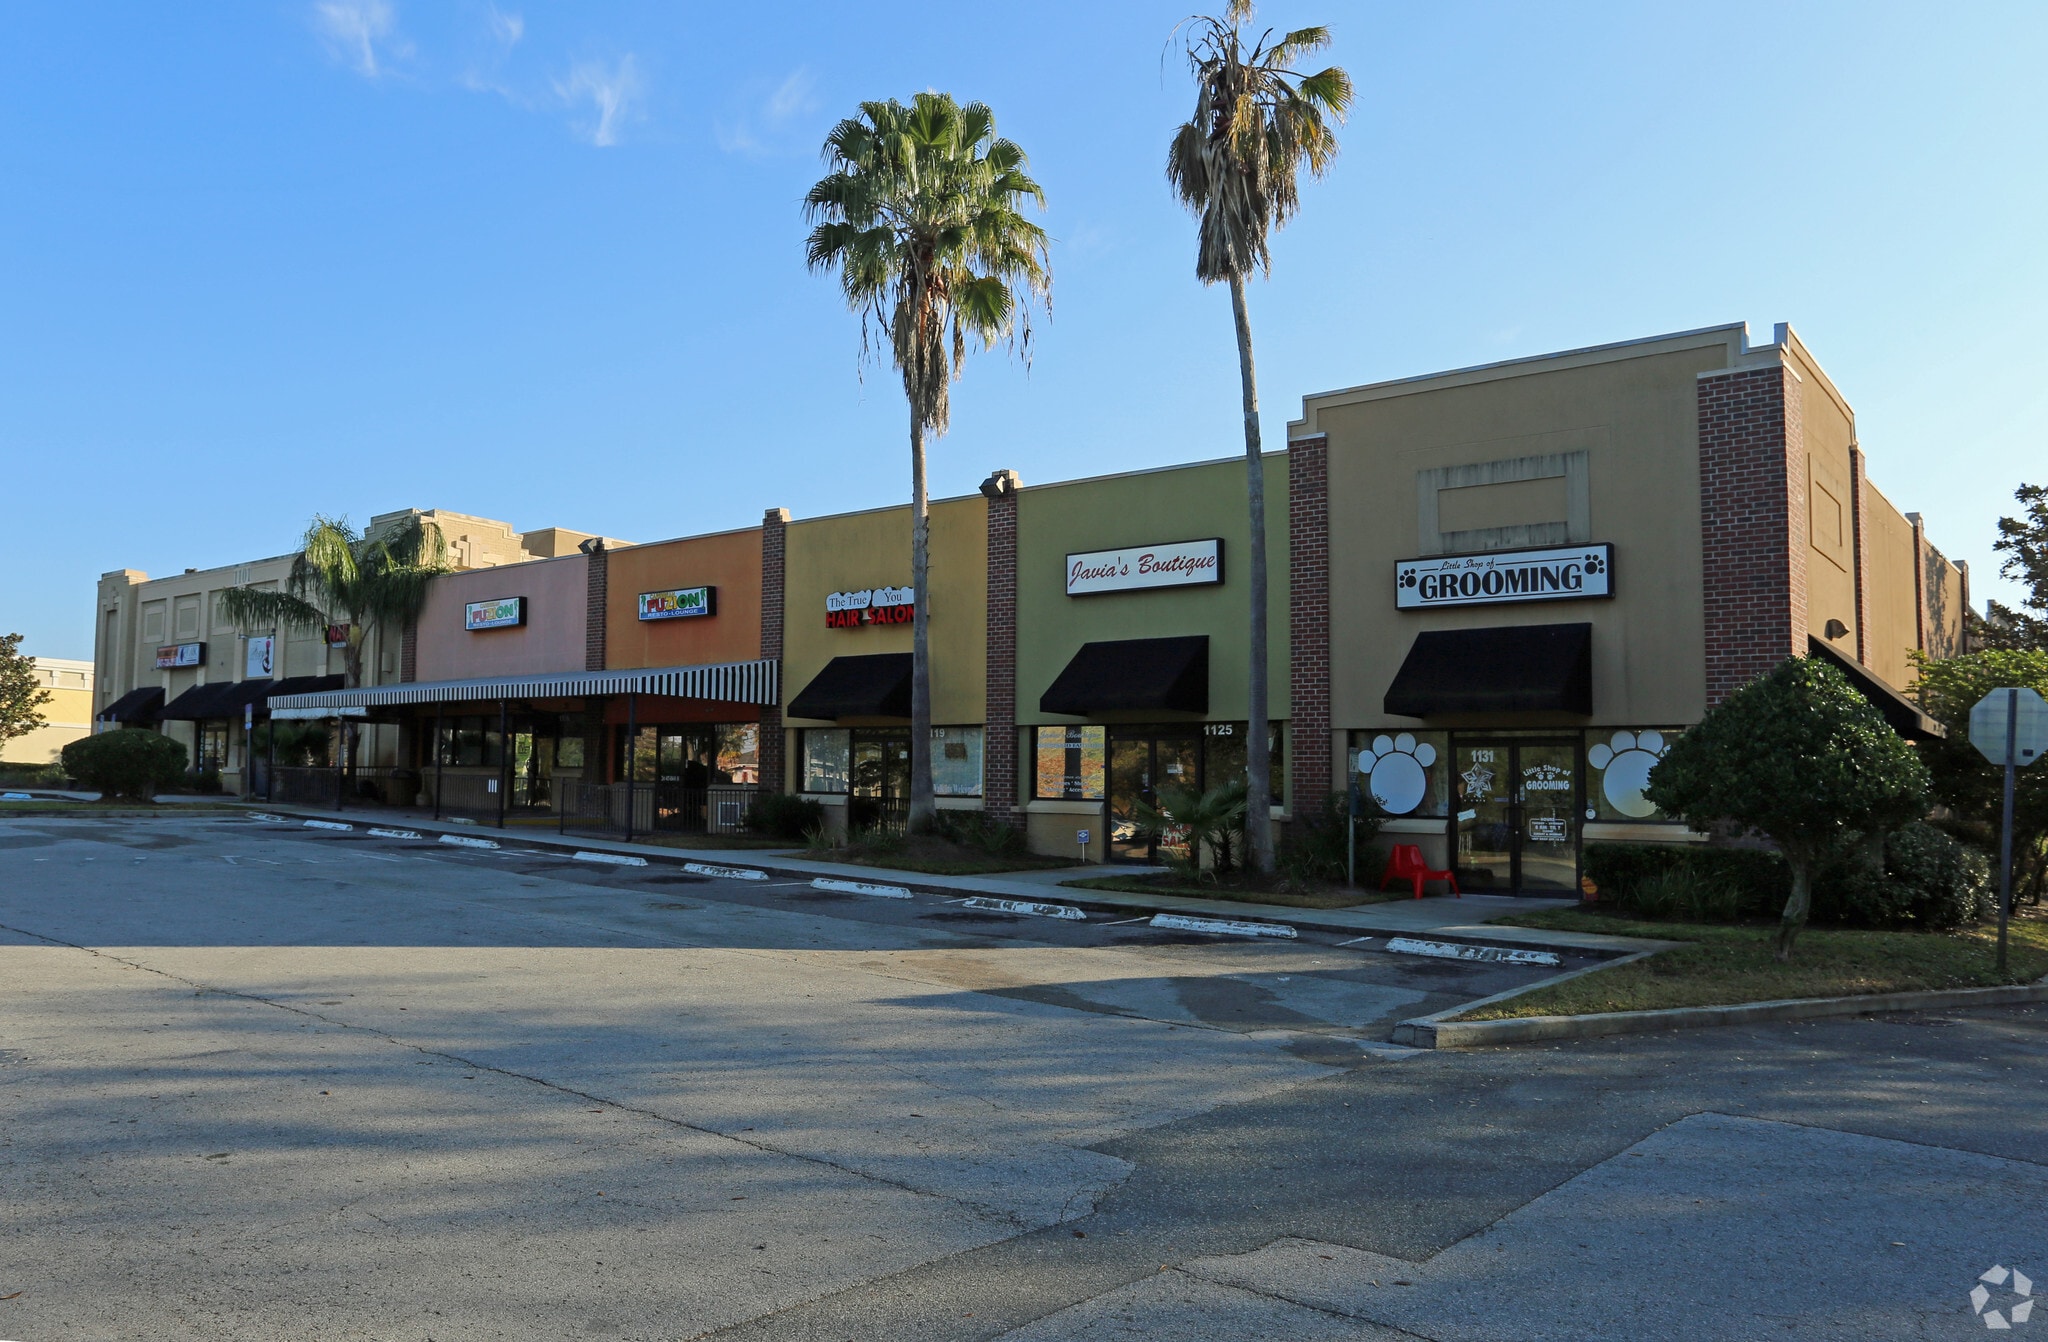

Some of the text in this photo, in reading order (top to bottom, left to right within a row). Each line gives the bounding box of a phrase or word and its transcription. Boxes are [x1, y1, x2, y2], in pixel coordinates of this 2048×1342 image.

[1069, 553, 1216, 587] Javia's Boutique
[1440, 557, 1496, 571] Little Shop of
[233, 567, 252, 585] 1101
[1419, 564, 1582, 599] GROOMING
[647, 592, 700, 613] FUZION
[829, 596, 867, 608] The True
[884, 592, 903, 603] You
[472, 604, 514, 623] FUZION
[826, 609, 860, 628] HAIR
[930, 728, 945, 738] 119
[1203, 724, 1233, 736] 1125
[1471, 750, 1494, 762] 1131
[1523, 764, 1571, 777] Little Shop of
[1526, 780, 1569, 790] GROOMING
